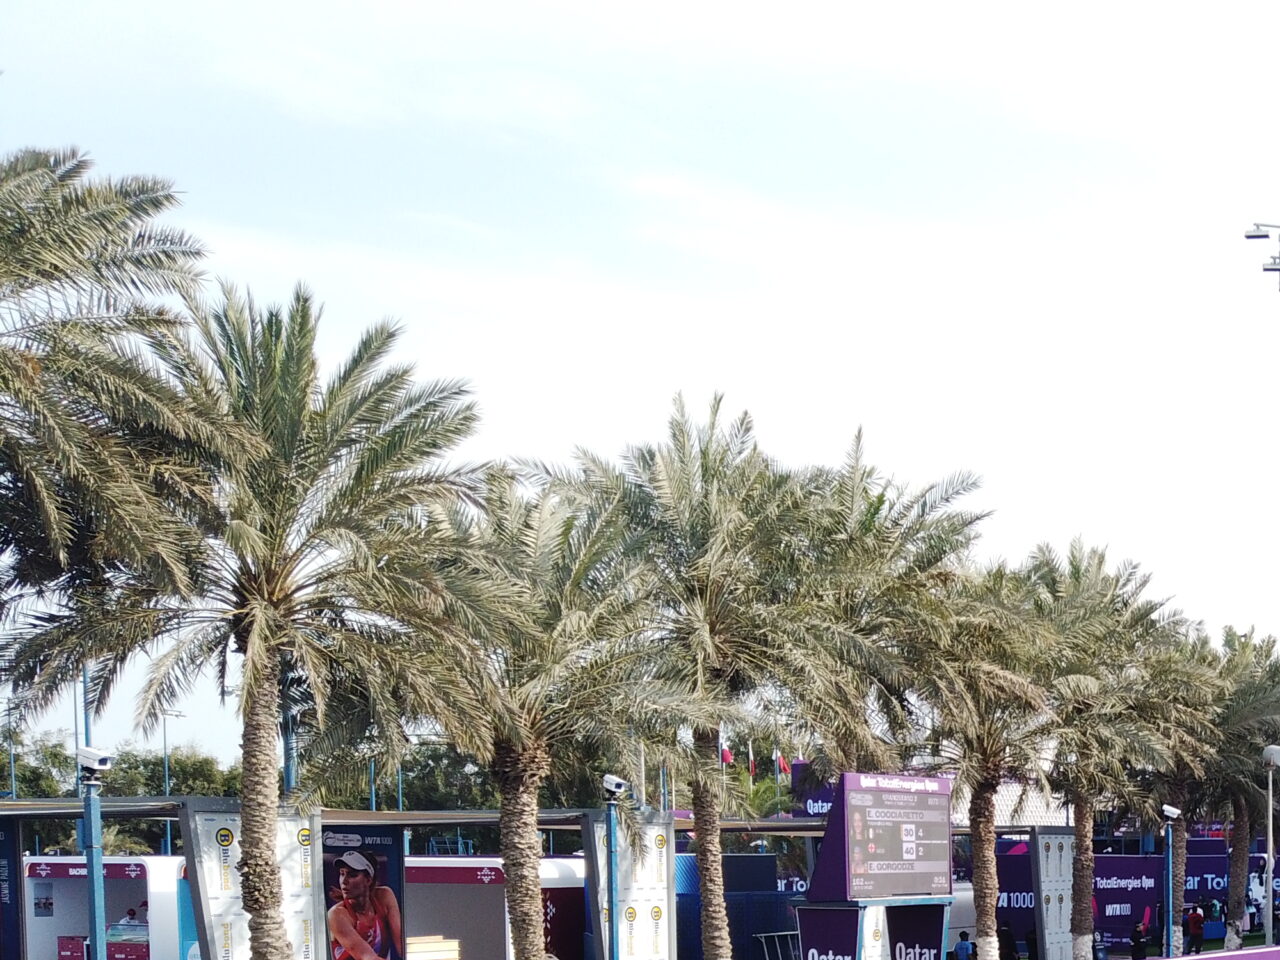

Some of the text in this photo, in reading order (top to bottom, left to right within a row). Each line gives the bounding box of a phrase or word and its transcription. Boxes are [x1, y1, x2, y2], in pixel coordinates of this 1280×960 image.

[806, 799, 833, 815] Qatar
[918, 828, 923, 837] 4
[904, 847, 924, 856] 40 2
[1095, 876, 1142, 891] TotalEnergies
[1141, 875, 1155, 890] Open
[1009, 892, 1035, 908] 1000
[1105, 904, 1121, 916] WTA
